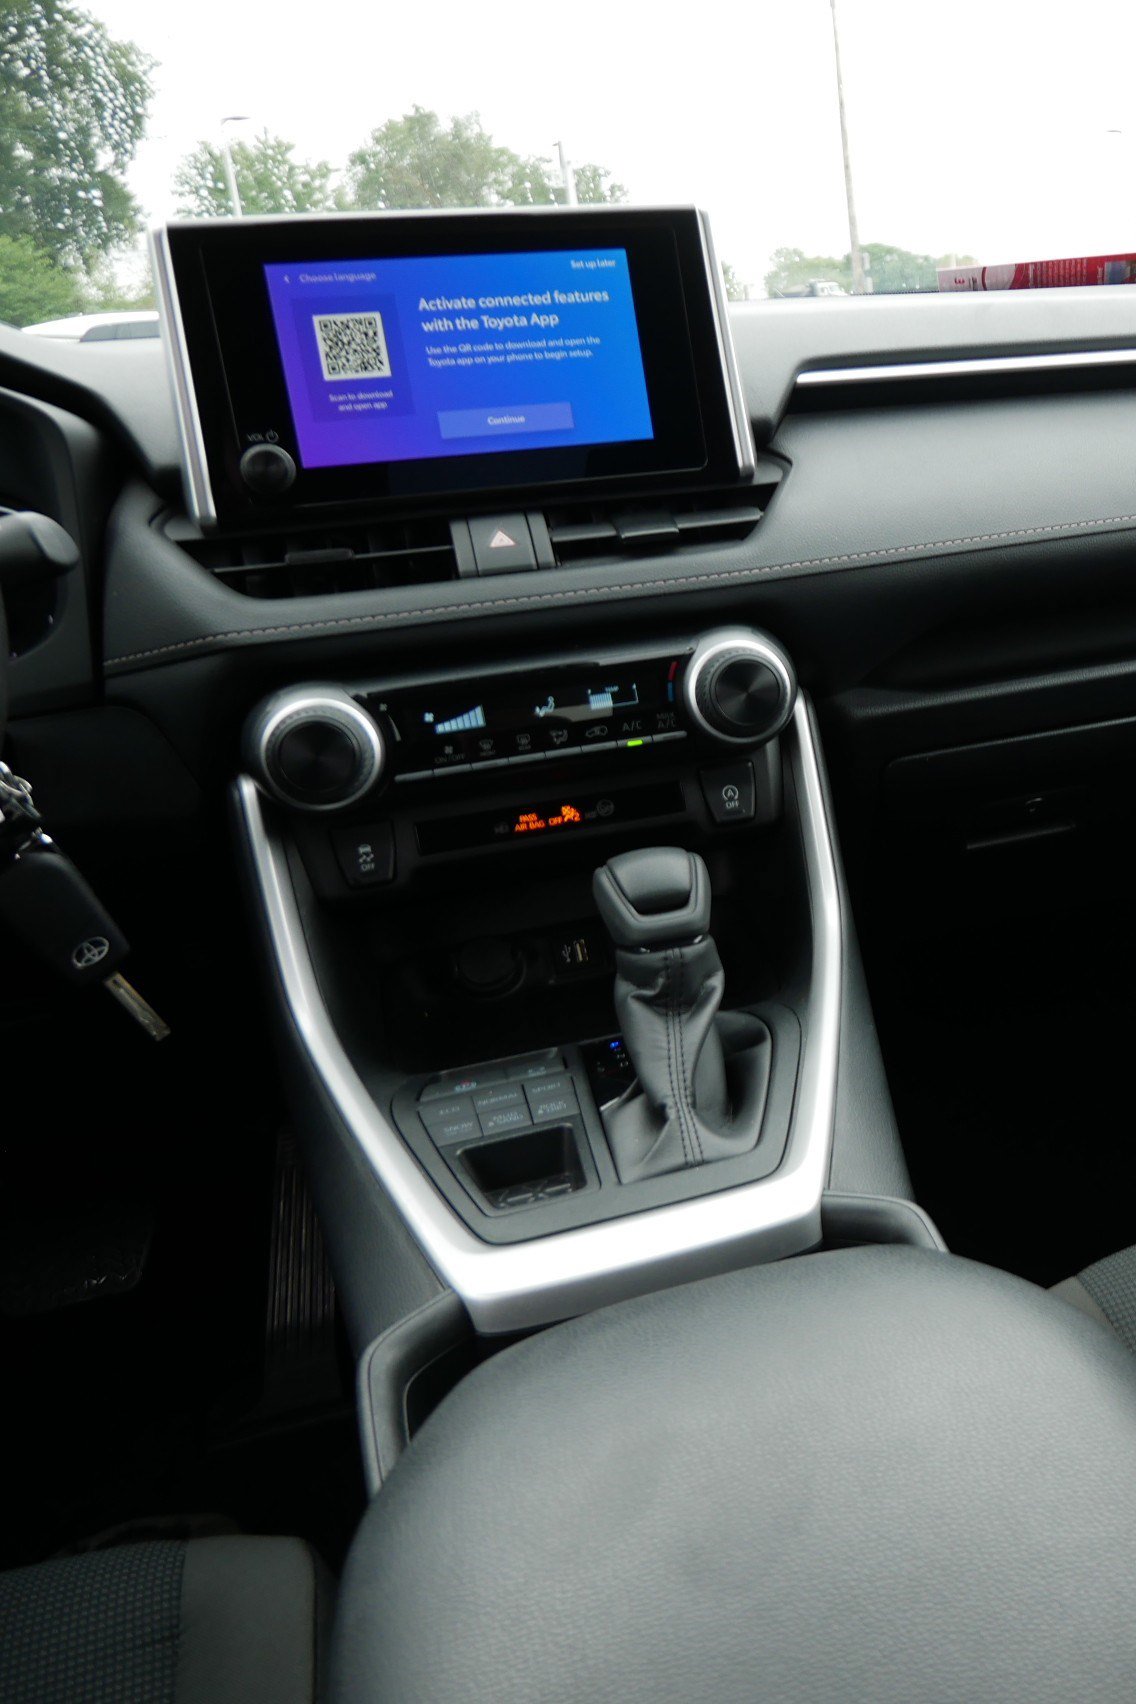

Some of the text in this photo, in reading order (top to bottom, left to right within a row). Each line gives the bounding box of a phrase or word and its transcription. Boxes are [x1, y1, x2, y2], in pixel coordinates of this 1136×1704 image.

[571, 258, 616, 270] Set up later
[300, 272, 376, 284] Choose language
[418, 289, 609, 311] Activate connected features
[421, 312, 559, 332] with the Toyota App
[426, 336, 600, 355] Use the QR code to download and open the
[428, 358, 456, 369] Toyota
[457, 357, 474, 367] app
[487, 356, 505, 365] your
[507, 353, 533, 363] phone
[535, 352, 544, 360] to
[545, 350, 568, 361] begin
[357, 390, 393, 401] download
[338, 401, 388, 412] and open app
[487, 415, 525, 426] Continue
[623, 721, 642, 732] A/C
[658, 719, 677, 729] A/C
[725, 800, 739, 809] OFF
[515, 823, 528, 832] AIR
[548, 816, 563, 826] OFF
[361, 863, 375, 872] OFF
